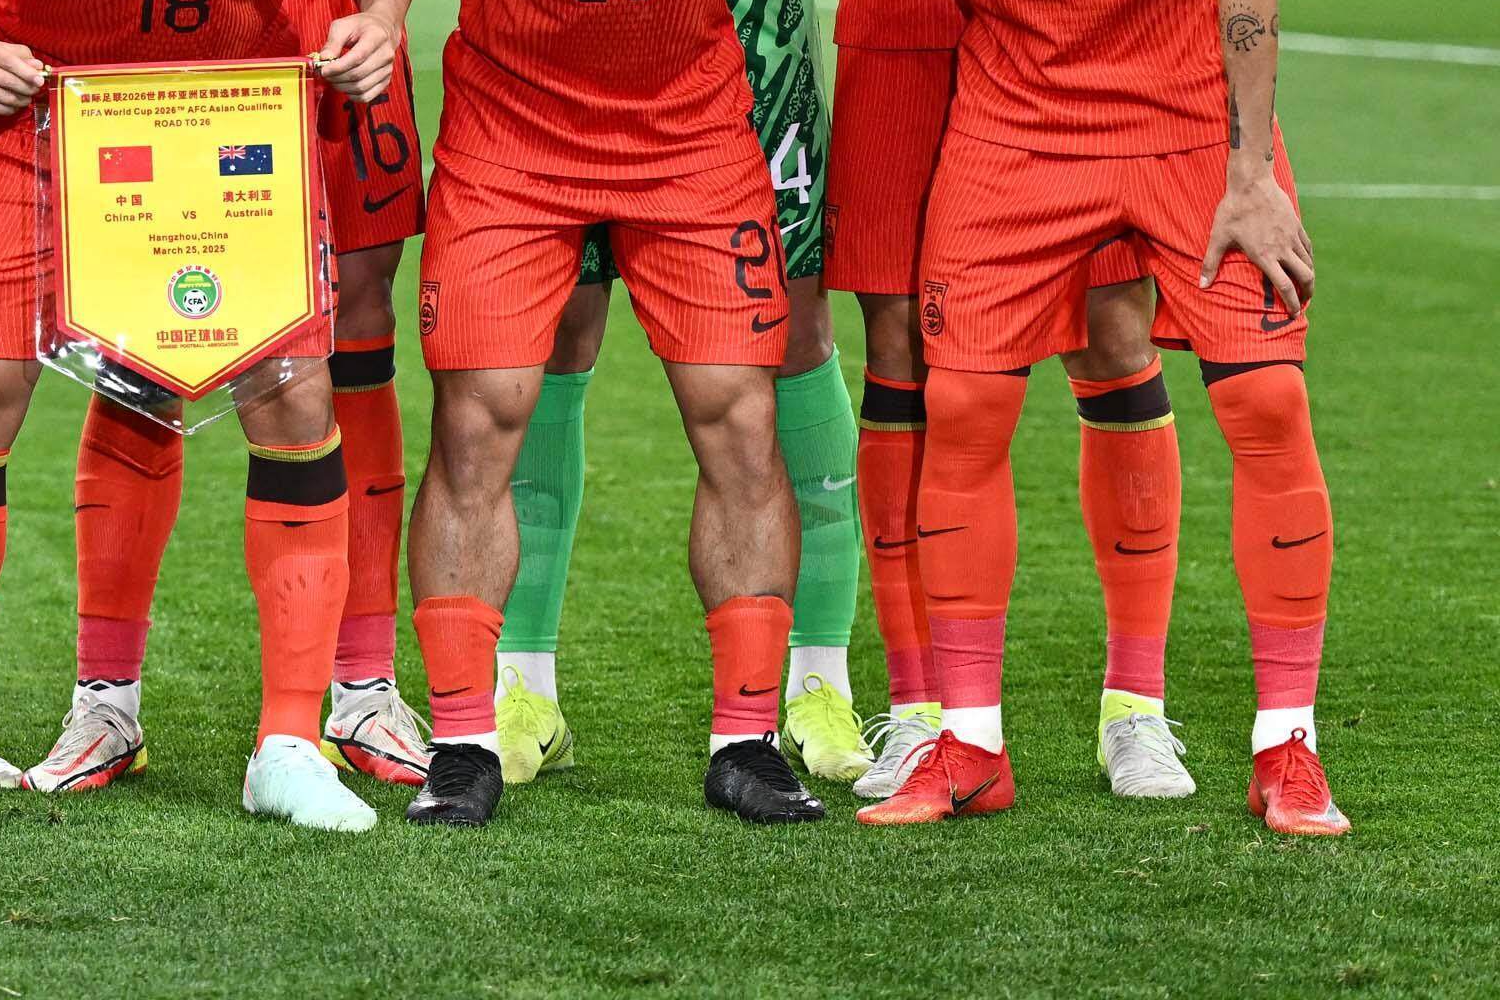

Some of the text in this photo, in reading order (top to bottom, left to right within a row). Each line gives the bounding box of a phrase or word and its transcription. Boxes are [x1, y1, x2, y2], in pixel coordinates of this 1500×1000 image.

[81, 109, 102, 117] FIFA
[104, 108, 131, 116] World
[134, 107, 152, 116] Cup
[188, 105, 207, 113] AFC
[209, 104, 235, 112] Asian
[238, 103, 283, 111] Qualifiers
[155, 118, 211, 127] ROAD TO 26
[344, 94, 411, 183] 16
[116, 194, 143, 207] 中国
[223, 190, 272, 202] 澳大利亚
[104, 213, 153, 222] China PR
[182, 211, 197, 220] VS
[225, 208, 273, 218] Australia
[153, 245, 226, 255] March 25, 2025
[925, 283, 945, 295] CFA
[188, 298, 203, 306] CFA
[156, 328, 238, 343] 中国足球协会
